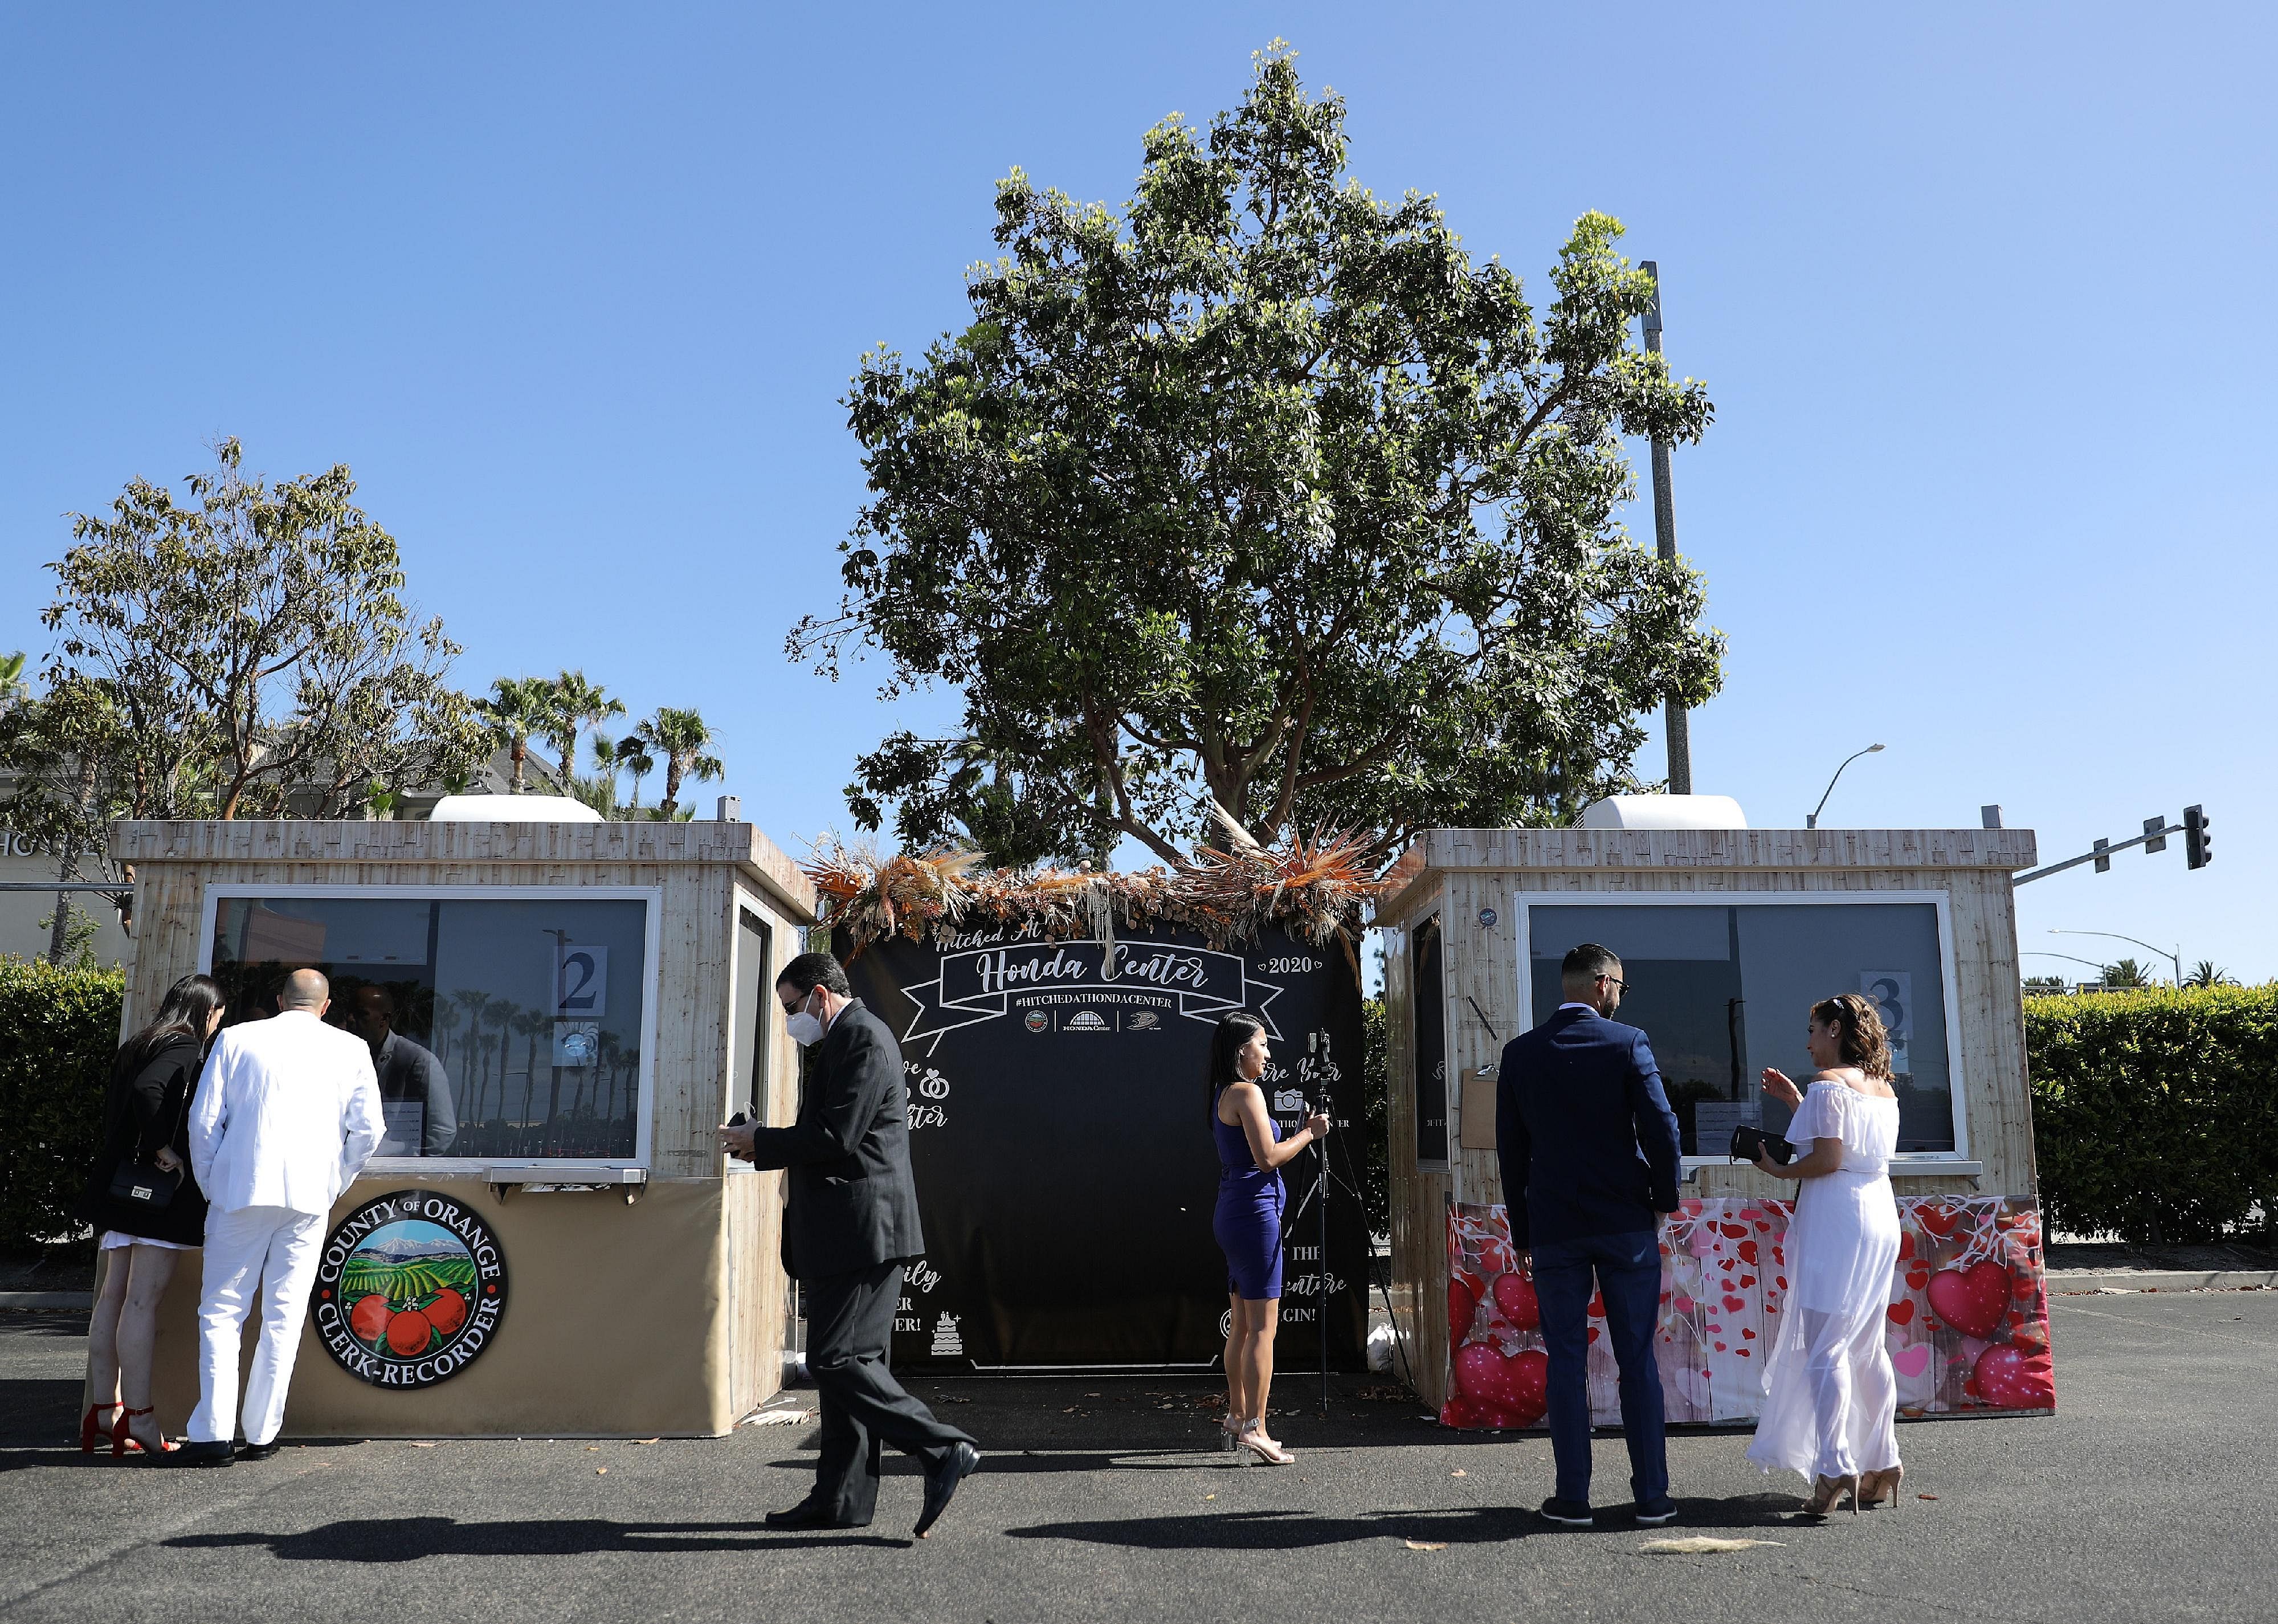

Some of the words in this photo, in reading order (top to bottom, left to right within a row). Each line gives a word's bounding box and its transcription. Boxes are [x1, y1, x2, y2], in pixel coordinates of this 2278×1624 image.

[1010, 919, 1045, 941] At
[558, 952, 597, 1009] 2
[976, 949, 1088, 992] Honda
[1101, 944, 1209, 988] Center
[1269, 957, 1312, 974] 2020
[1016, 994, 1172, 1009] #HITCHEDATHONDACENTER
[1869, 978, 1904, 1031] 3
[1297, 1057, 1342, 1083] Yor
[320, 1199, 397, 1282] COUNTY
[402, 1201, 421, 1212] OF
[424, 1199, 501, 1279] ORANGE
[318, 1297, 501, 1385] CLERK-RECORDER
